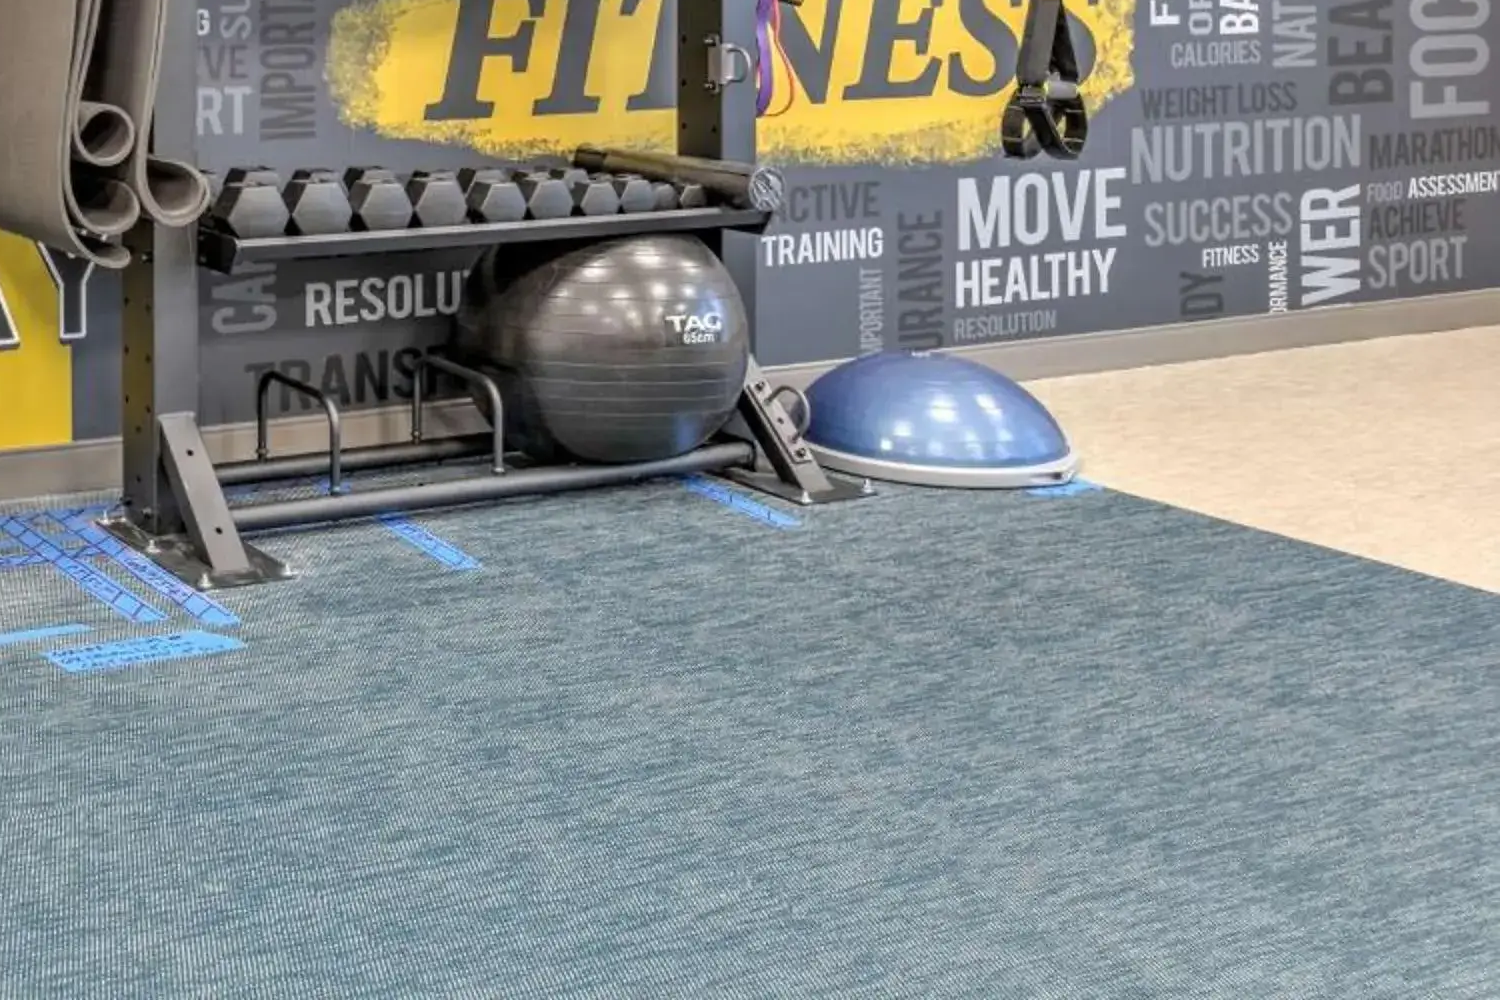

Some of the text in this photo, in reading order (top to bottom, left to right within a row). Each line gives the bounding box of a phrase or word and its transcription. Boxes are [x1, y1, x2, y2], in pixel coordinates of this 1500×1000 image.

[1171, 40, 1263, 69] CALORIES
[1140, 81, 1298, 121] WEIGHT LOSS
[1131, 113, 1361, 184] NUTRITION
[957, 167, 1128, 252] MOVE
[1144, 191, 1294, 247] SUCCESS
[1368, 198, 1468, 240] ACHIEVE
[761, 226, 885, 268] TRAINING
[1202, 244, 1260, 269] FITNESS
[1300, 183, 1362, 307] WER
[1368, 235, 1469, 289] SPORT
[304, 269, 472, 327] RESOLU
[955, 247, 1118, 309] HEALTHY
[665, 311, 722, 333] TAG
[954, 310, 1058, 342] RESOLUTION
